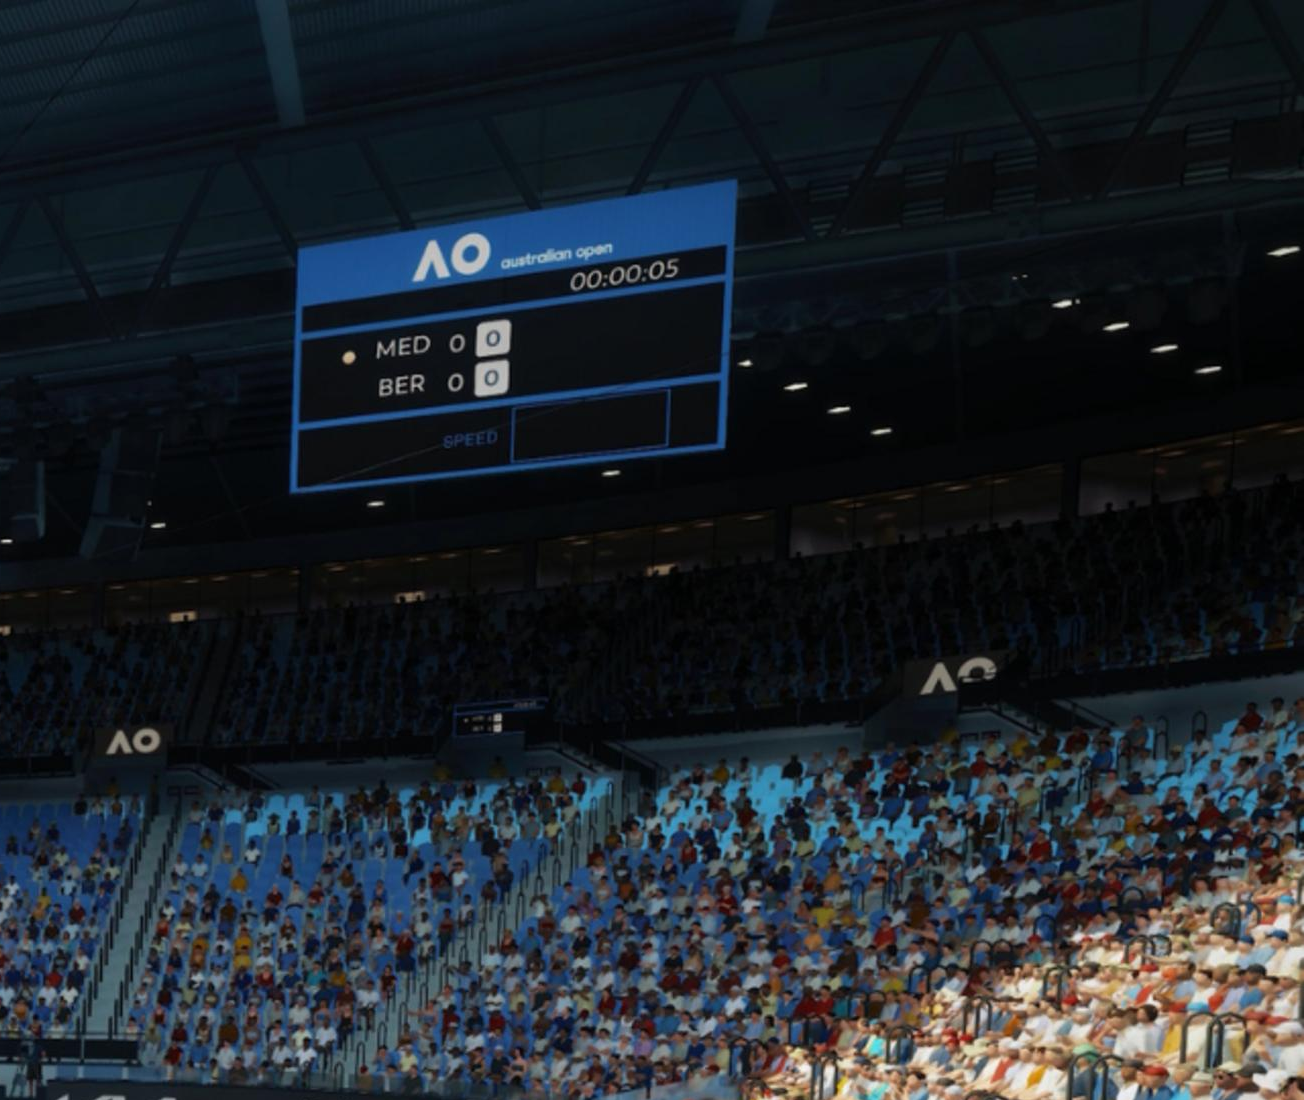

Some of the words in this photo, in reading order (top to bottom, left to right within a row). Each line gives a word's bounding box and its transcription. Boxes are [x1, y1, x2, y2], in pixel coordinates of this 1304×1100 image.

[412, 232, 491, 282] AO
[501, 248, 572, 270] australian
[576, 243, 612, 260] open
[570, 258, 680, 291] 00:00:05
[375, 335, 431, 360] MED
[449, 334, 465, 352] 0
[486, 330, 501, 348] 0
[378, 375, 425, 398] BER
[448, 373, 464, 393] 0
[484, 369, 499, 387] 0
[443, 431, 498, 449] SPEED
[106, 728, 161, 755] AO
